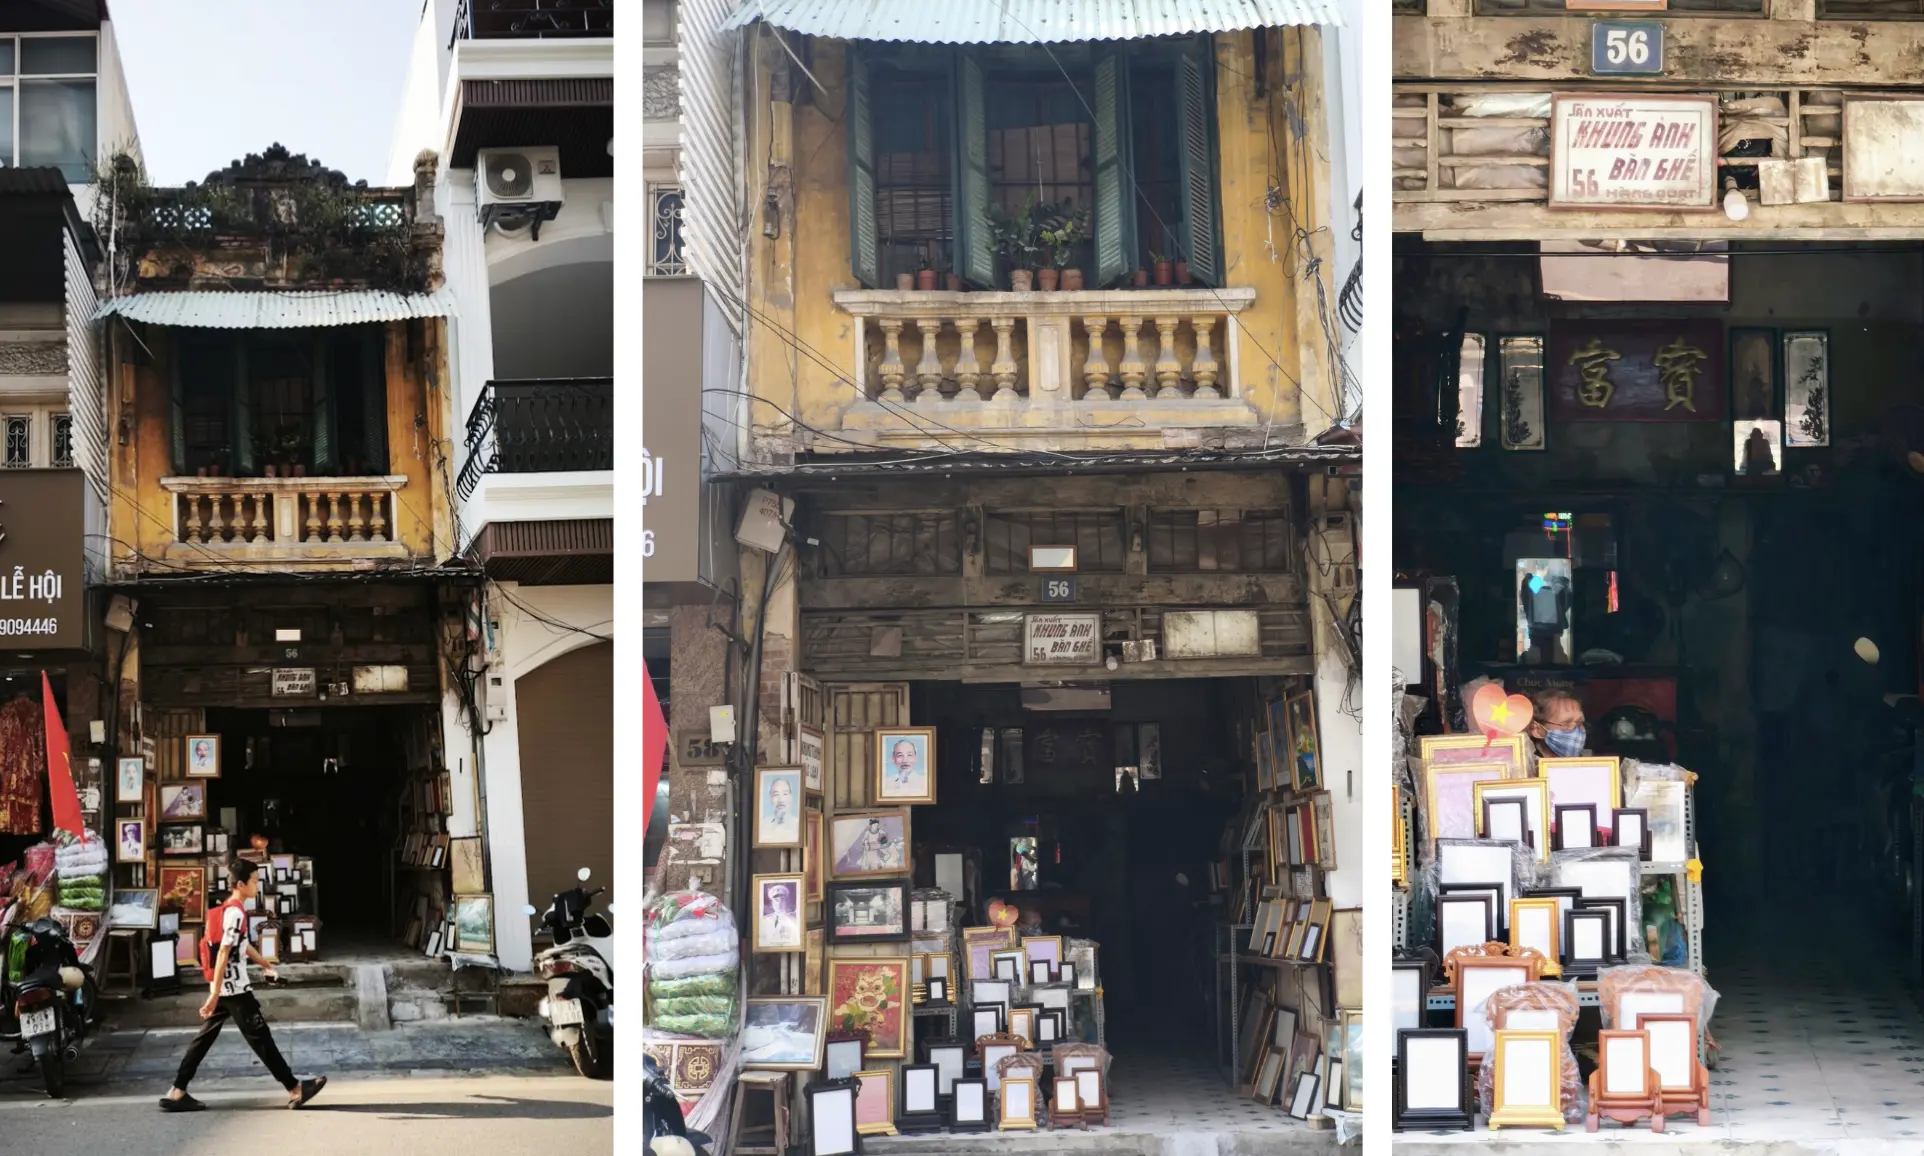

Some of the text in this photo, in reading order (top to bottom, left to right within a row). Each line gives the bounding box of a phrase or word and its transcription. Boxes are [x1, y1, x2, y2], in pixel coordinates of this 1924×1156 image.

[1606, 30, 1649, 64] 56
[1572, 120, 1646, 148] KHUNG
[1572, 168, 1598, 197] 56
[1, 566, 62, 604] LỄ HỘI
[1048, 581, 1069, 597] 56
[0, 618, 57, 635] 9094446
[1033, 624, 1069, 638] KHUNG
[286, 648, 298, 658] 56
[1033, 647, 1046, 660] 56
